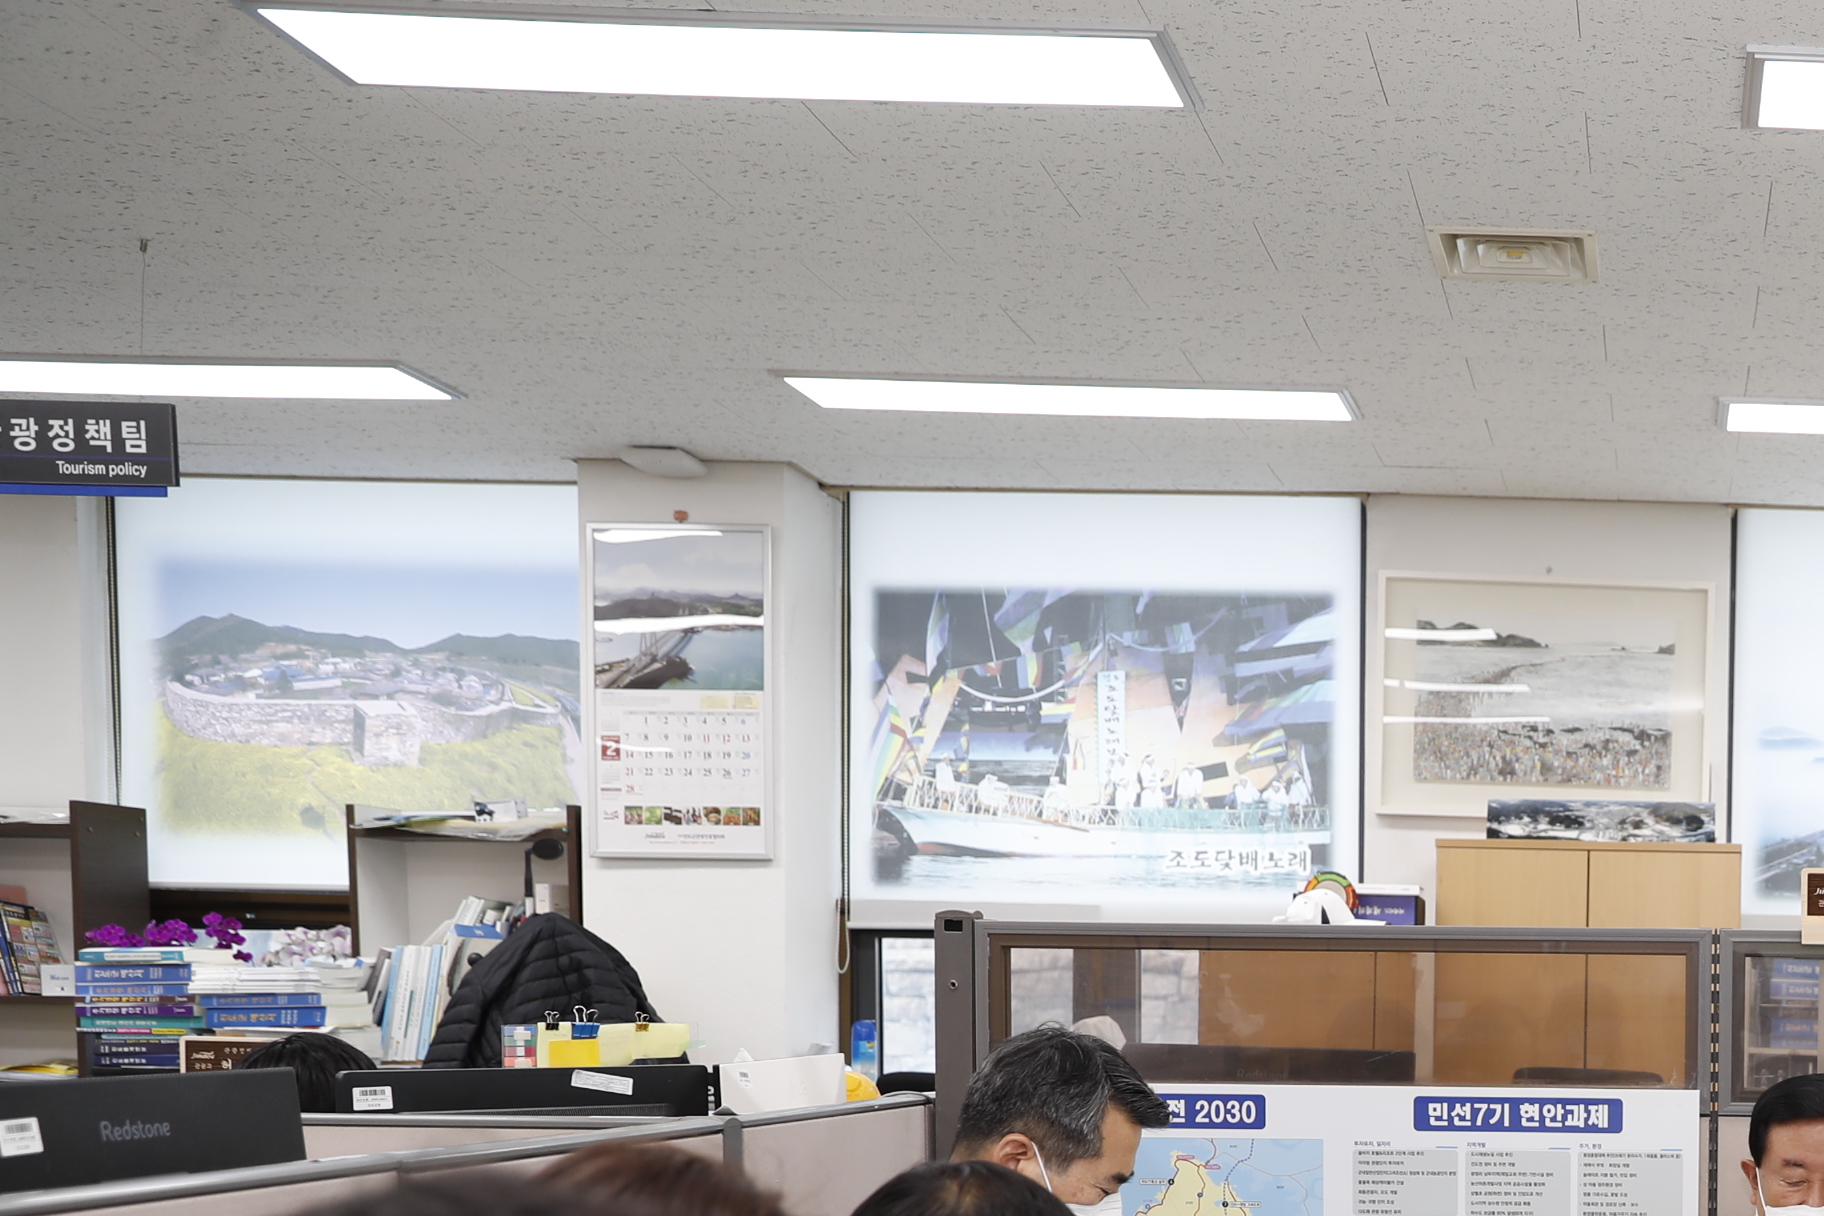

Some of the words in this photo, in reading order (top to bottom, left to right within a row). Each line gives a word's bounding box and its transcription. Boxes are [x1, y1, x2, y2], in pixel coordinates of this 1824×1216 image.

[0, 417, 147, 453] 광정책팀
[56, 461, 106, 475] Tourism
[109, 463, 147, 478] policy
[606, 741, 616, 757] 2
[1194, 1100, 1257, 1124] 2030
[1427, 1102, 1510, 1127] 민선7기
[1518, 1103, 1609, 1129] 현안과제
[101, 1120, 171, 1142] Redstone
